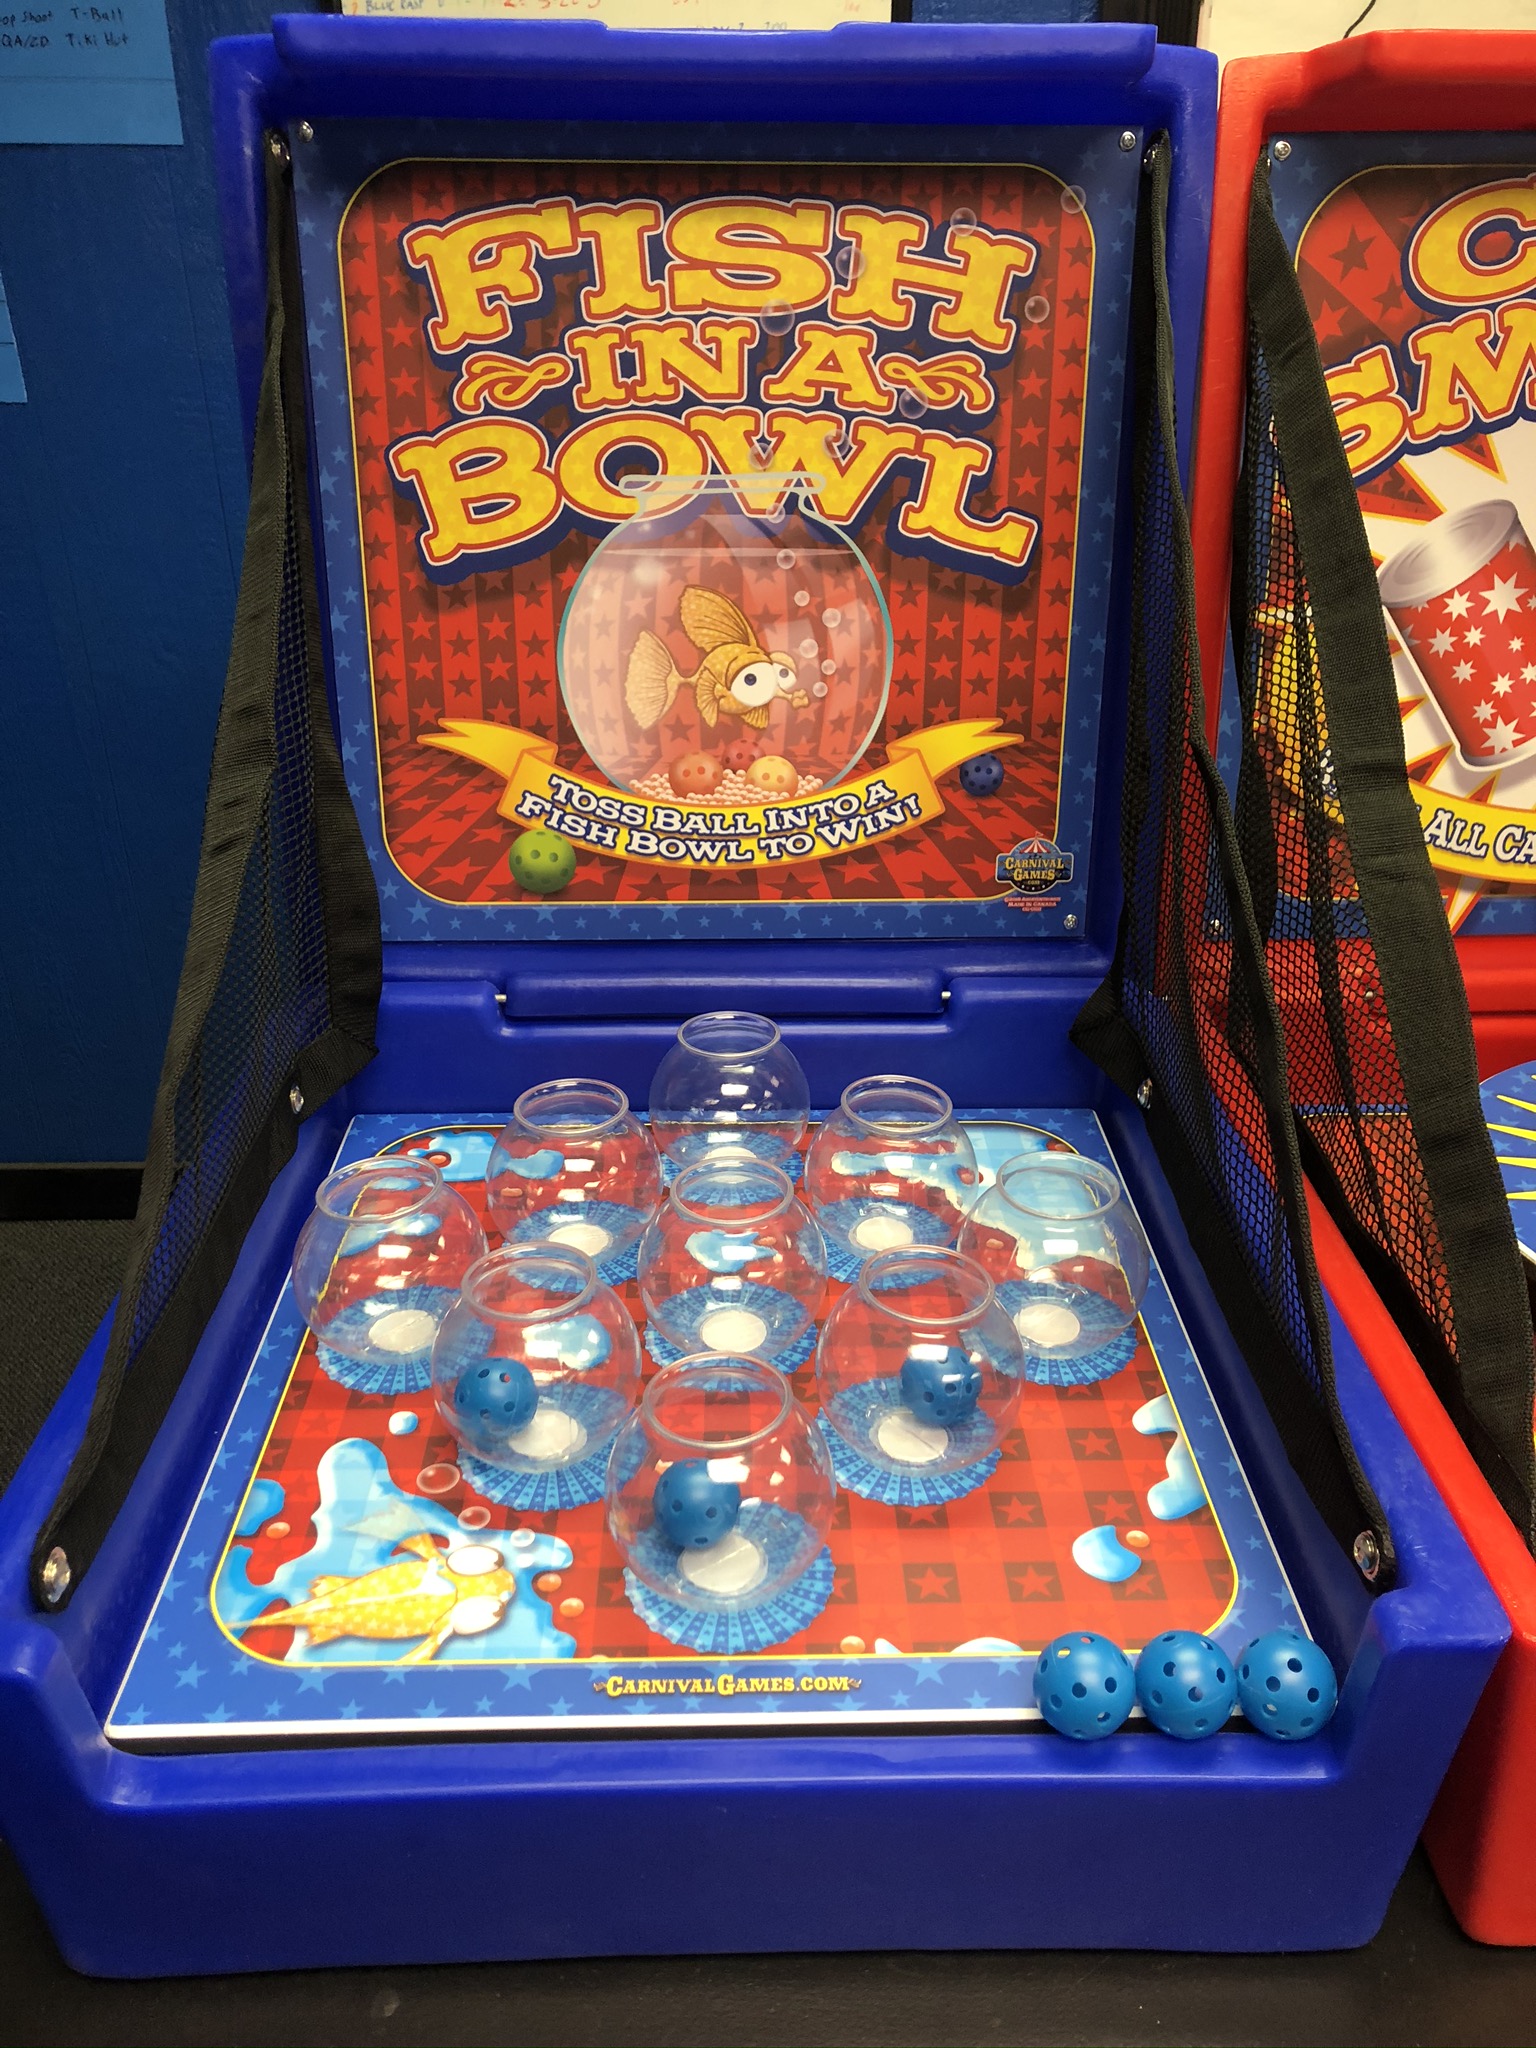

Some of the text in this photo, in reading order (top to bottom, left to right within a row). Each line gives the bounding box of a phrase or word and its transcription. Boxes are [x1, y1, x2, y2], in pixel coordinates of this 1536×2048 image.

[0, 14, 16, 26] op
[70, 7, 124, 23] T-Ball
[405, 197, 1036, 353] FISH
[567, 319, 896, 412] IN A
[390, 408, 1040, 567] BOWL
[516, 791, 922, 863] FISH BOWL TO WIN!
[549, 774, 898, 836] TOSS BALL INTO A
[1423, 807, 1489, 858] ALL
[1005, 857, 1064, 869] CARNIVAL
[1013, 868, 1055, 881] GAMES
